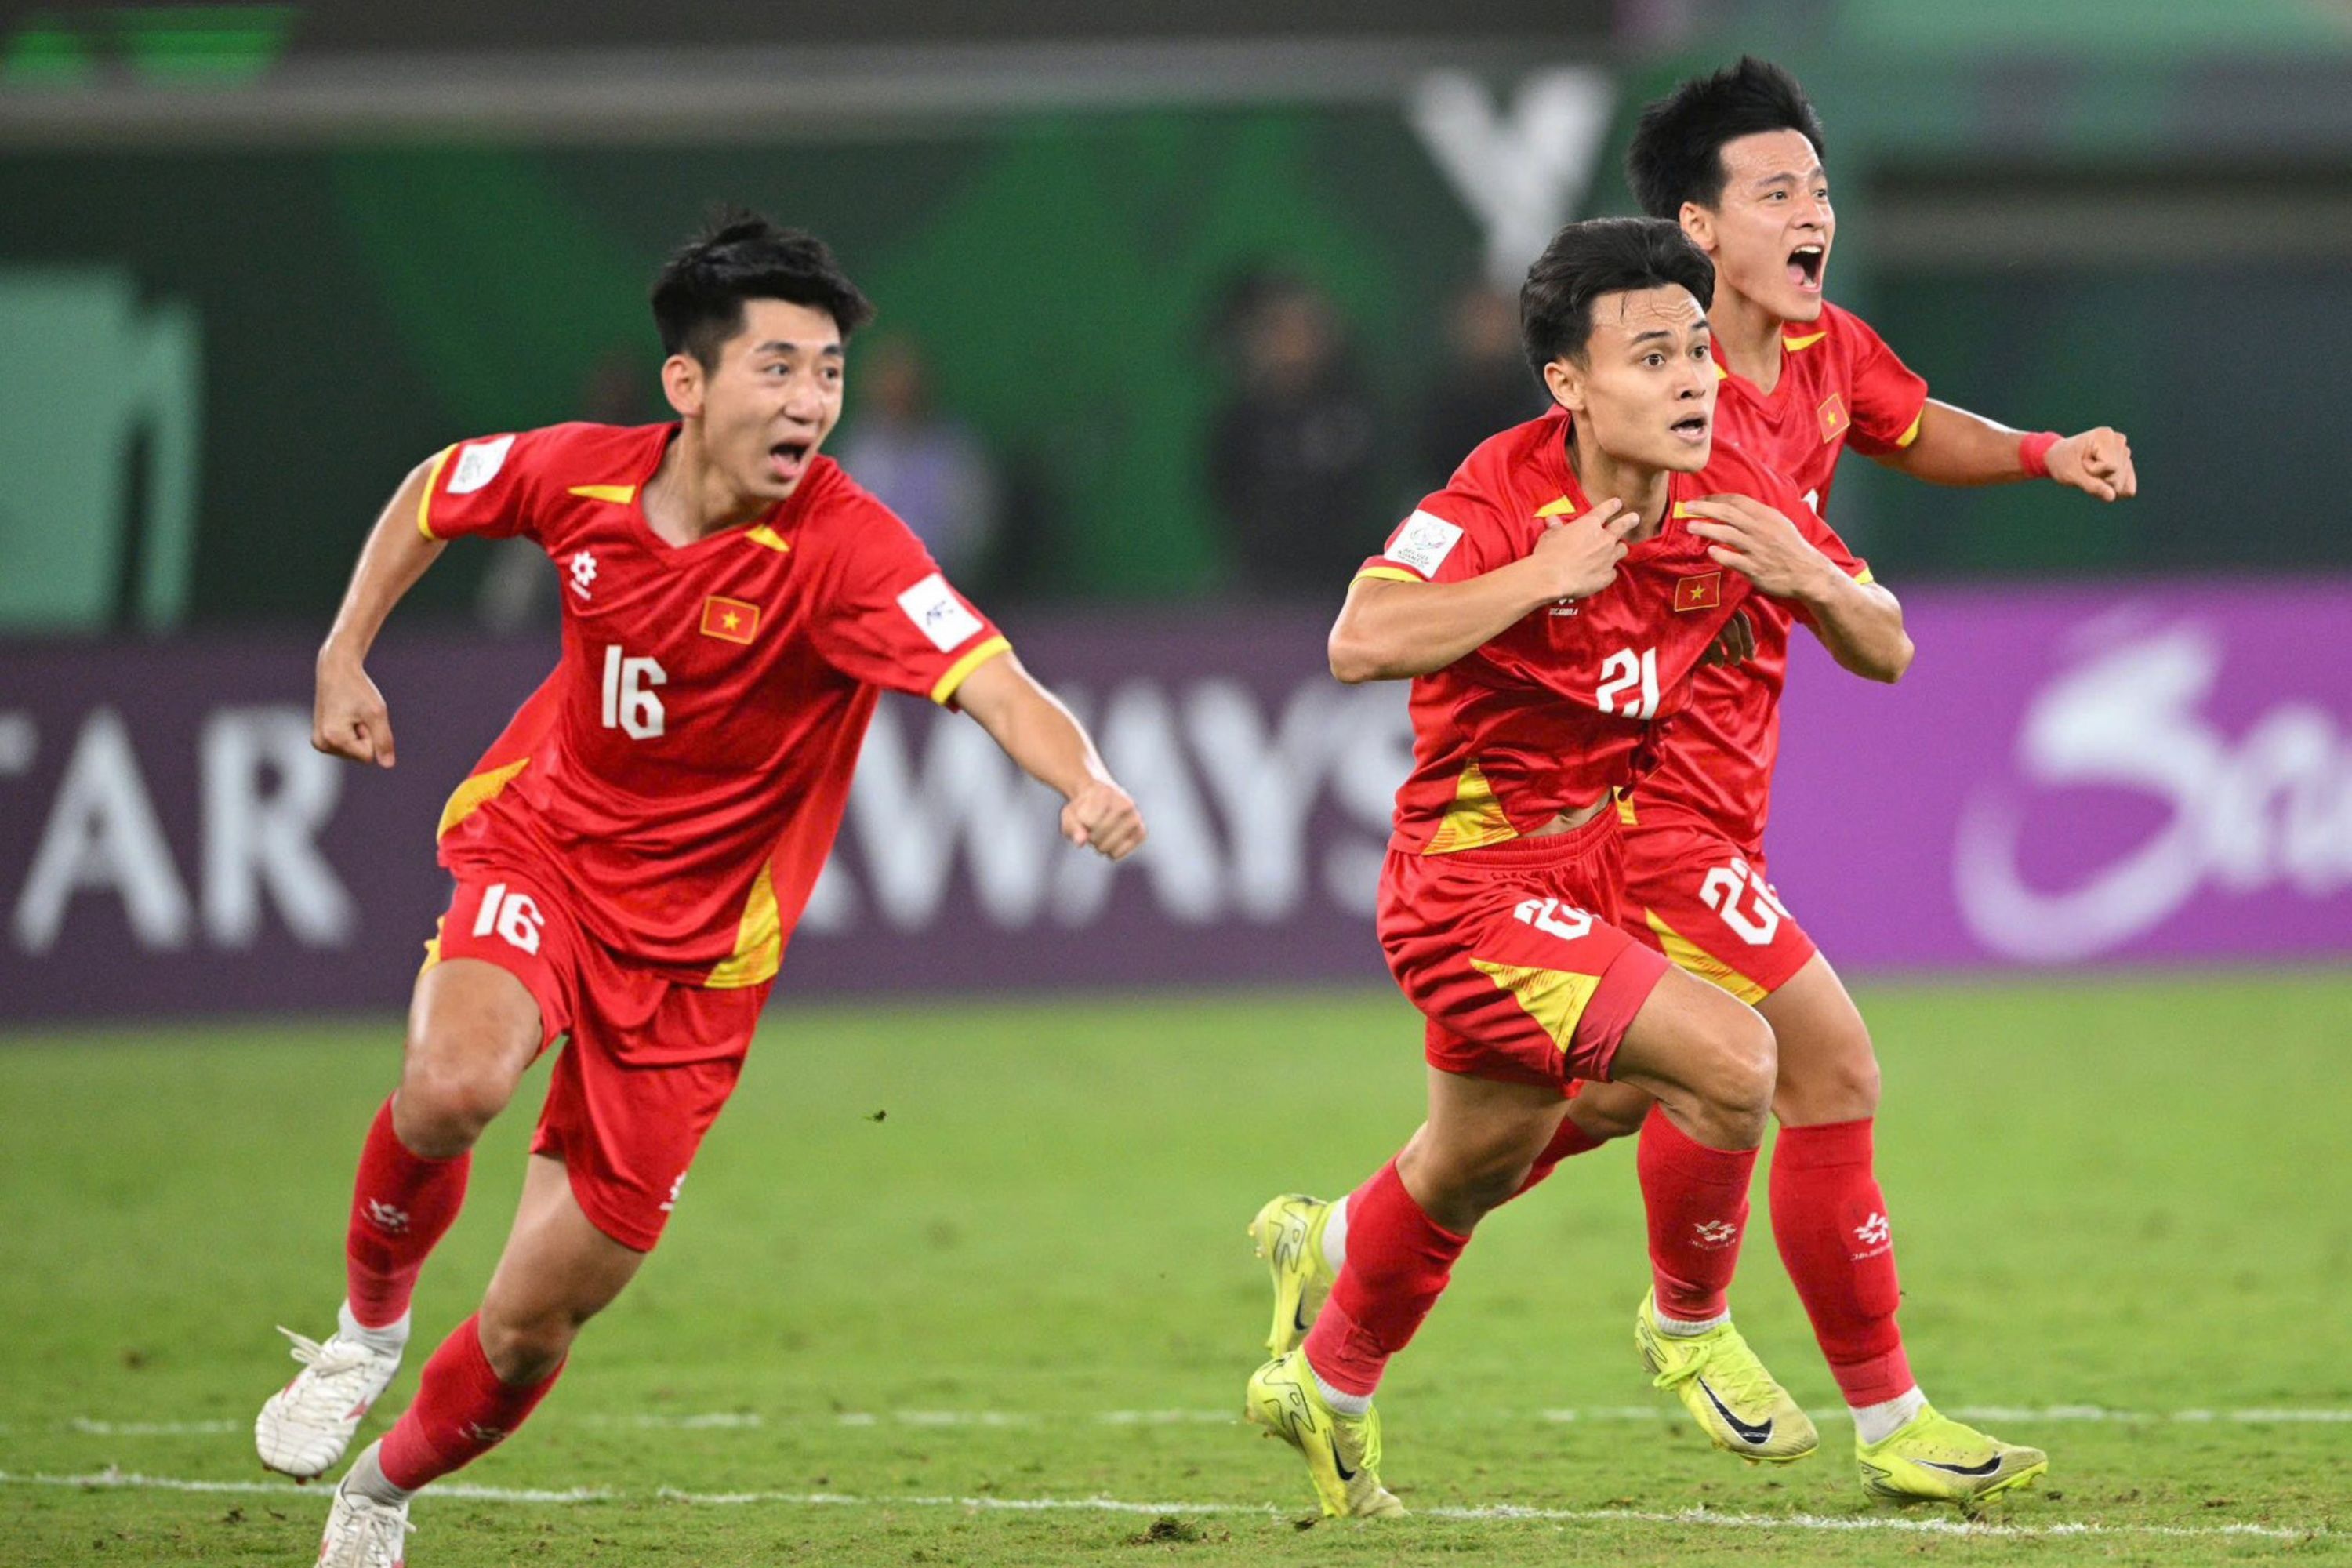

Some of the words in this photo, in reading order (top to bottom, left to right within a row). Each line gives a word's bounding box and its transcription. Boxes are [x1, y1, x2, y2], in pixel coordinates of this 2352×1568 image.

[602, 644, 667, 740] 16
[1595, 646, 1660, 720] 21
[472, 883, 545, 956] 16
